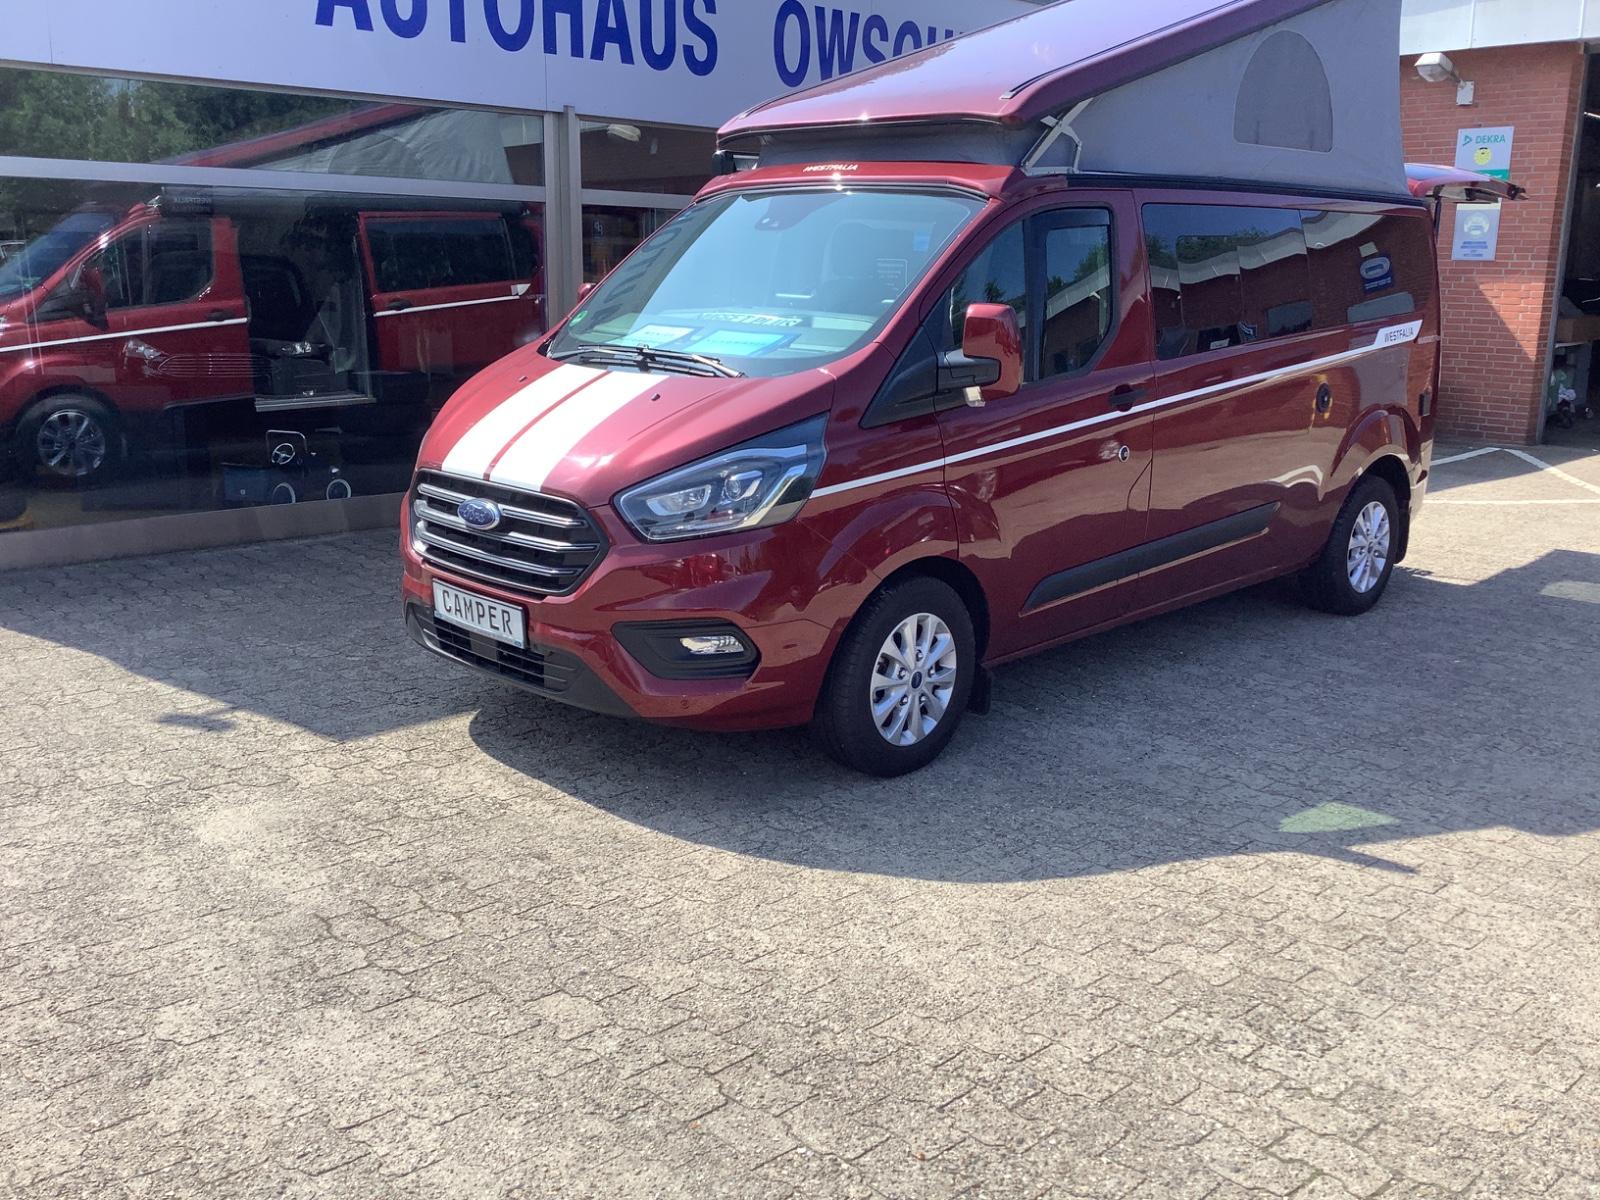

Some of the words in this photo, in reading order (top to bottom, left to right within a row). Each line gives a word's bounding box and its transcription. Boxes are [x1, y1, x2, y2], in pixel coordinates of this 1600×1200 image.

[774, 0, 964, 87] OWS
[1475, 134, 1506, 144] DEKRA
[1384, 327, 1414, 343] WESTFALIA
[441, 589, 513, 636] CAMPER
